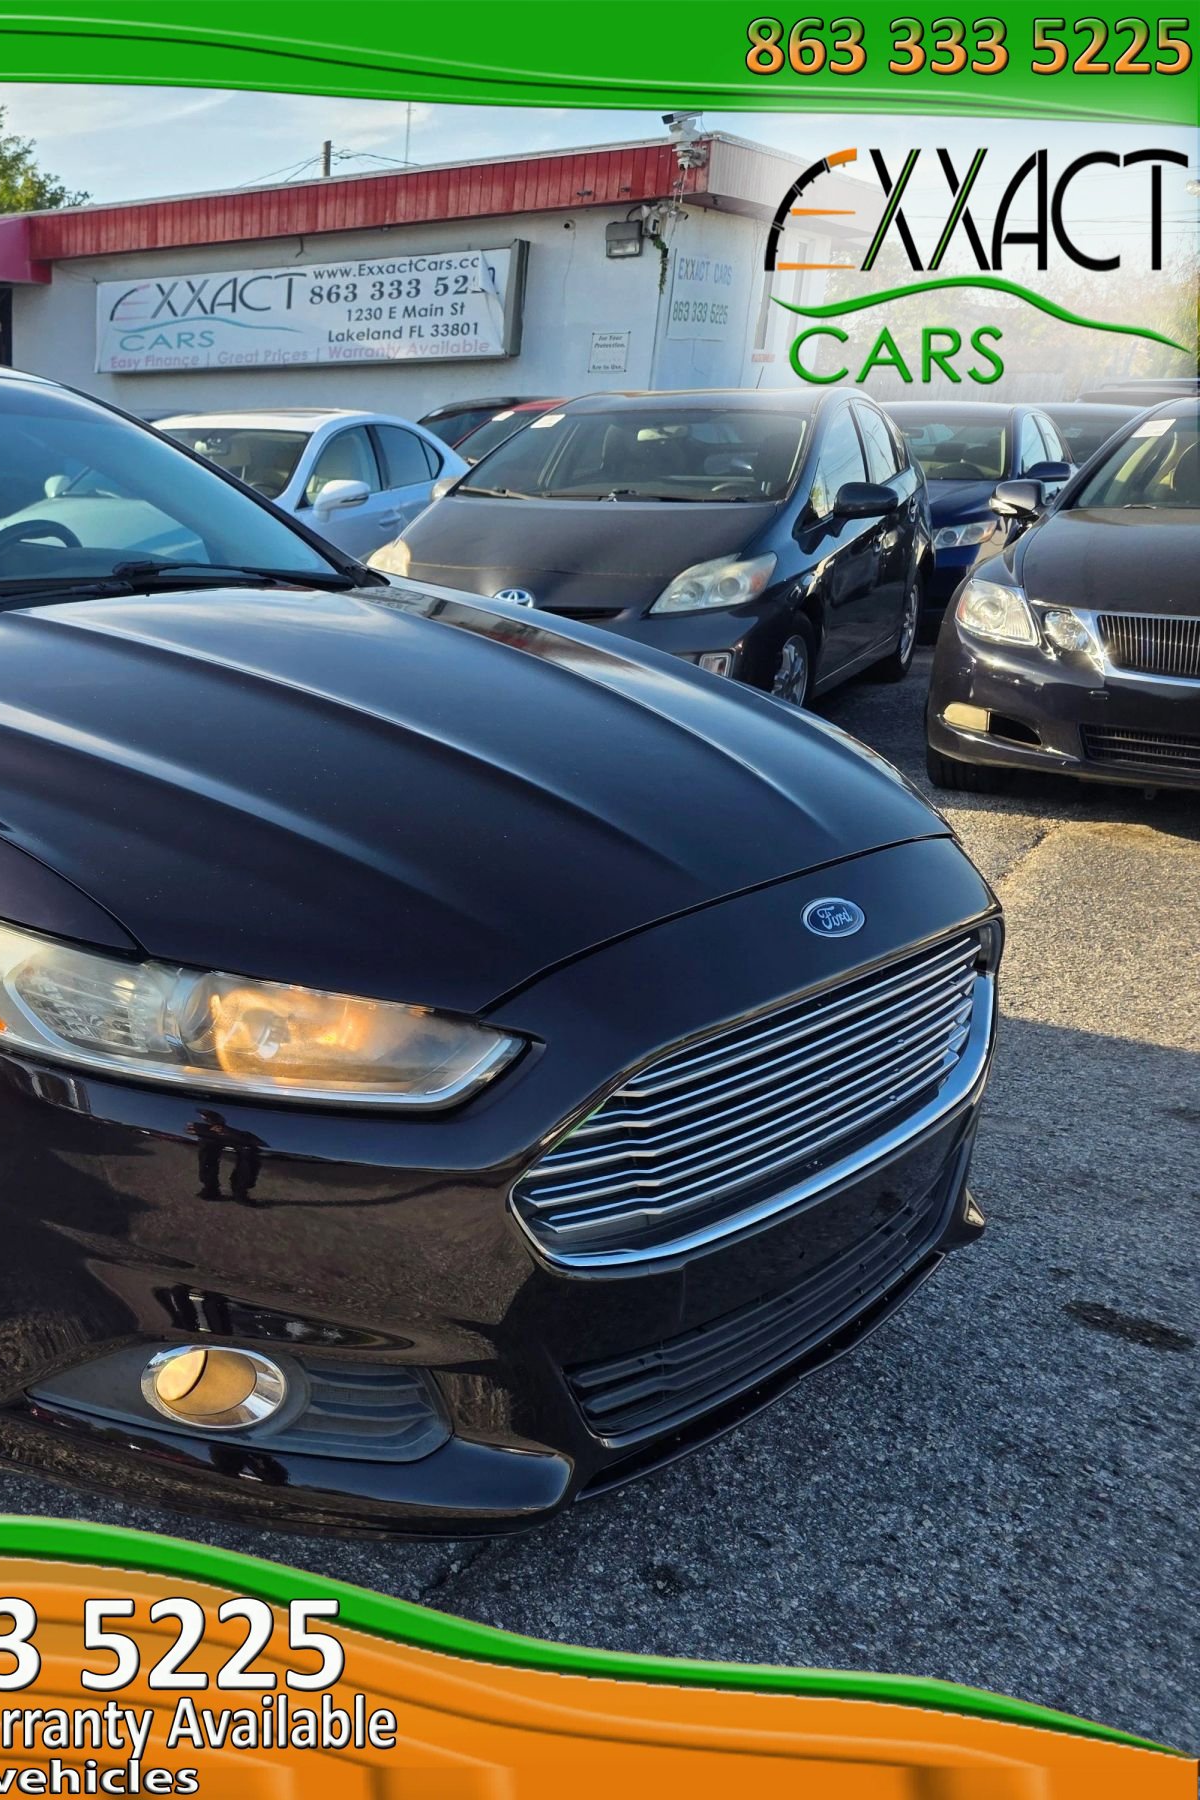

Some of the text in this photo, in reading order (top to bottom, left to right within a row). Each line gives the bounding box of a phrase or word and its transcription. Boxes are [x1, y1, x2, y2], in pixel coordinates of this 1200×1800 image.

[110, 272, 307, 321] EXXACT
[309, 283, 357, 305] 863
[370, 278, 421, 300] 333
[347, 302, 465, 322] 1230 E Main St
[119, 330, 215, 351] CARS
[328, 322, 478, 342] Lakeland FL 33801
[110, 339, 490, 369] Easy Finance Great Prices Warranty Available
[817, 905, 853, 930] Ford
